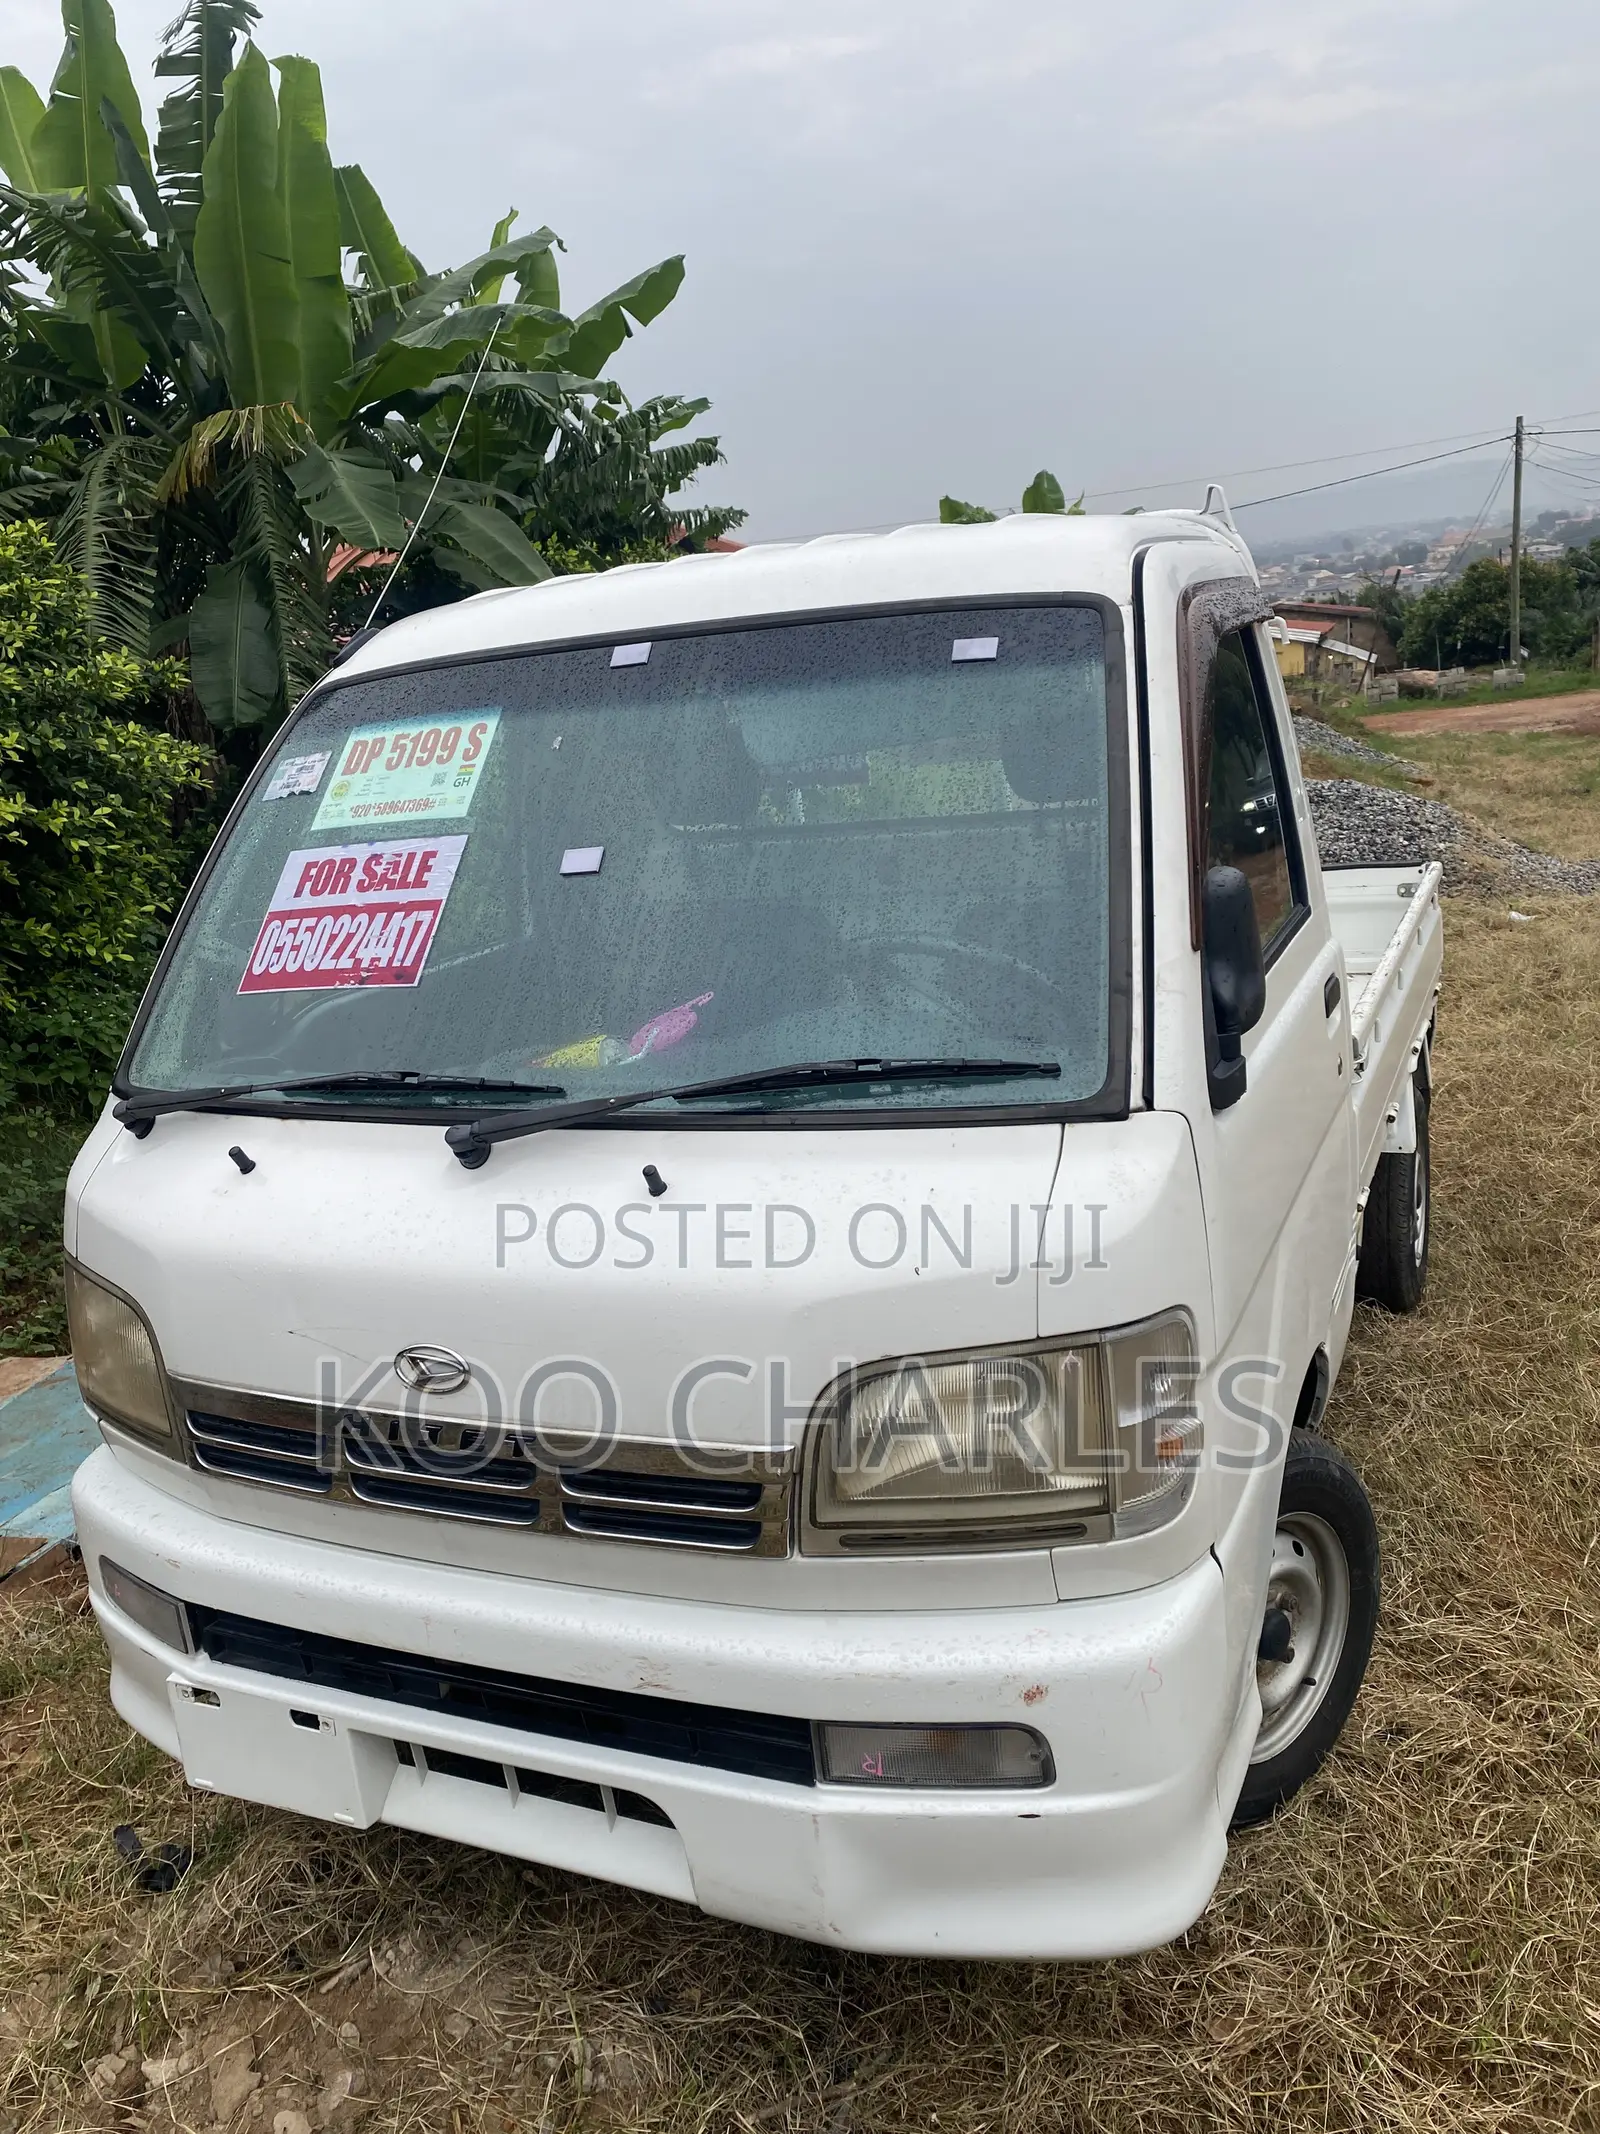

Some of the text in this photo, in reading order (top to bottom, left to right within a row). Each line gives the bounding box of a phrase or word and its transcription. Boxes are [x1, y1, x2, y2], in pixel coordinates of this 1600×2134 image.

[343, 738, 386, 776] DP
[385, 726, 462, 772] 5199
[463, 722, 488, 763] S
[453, 776, 471, 788] GH
[293, 850, 438, 898] FOR SALE
[253, 912, 434, 976] 0550224417
